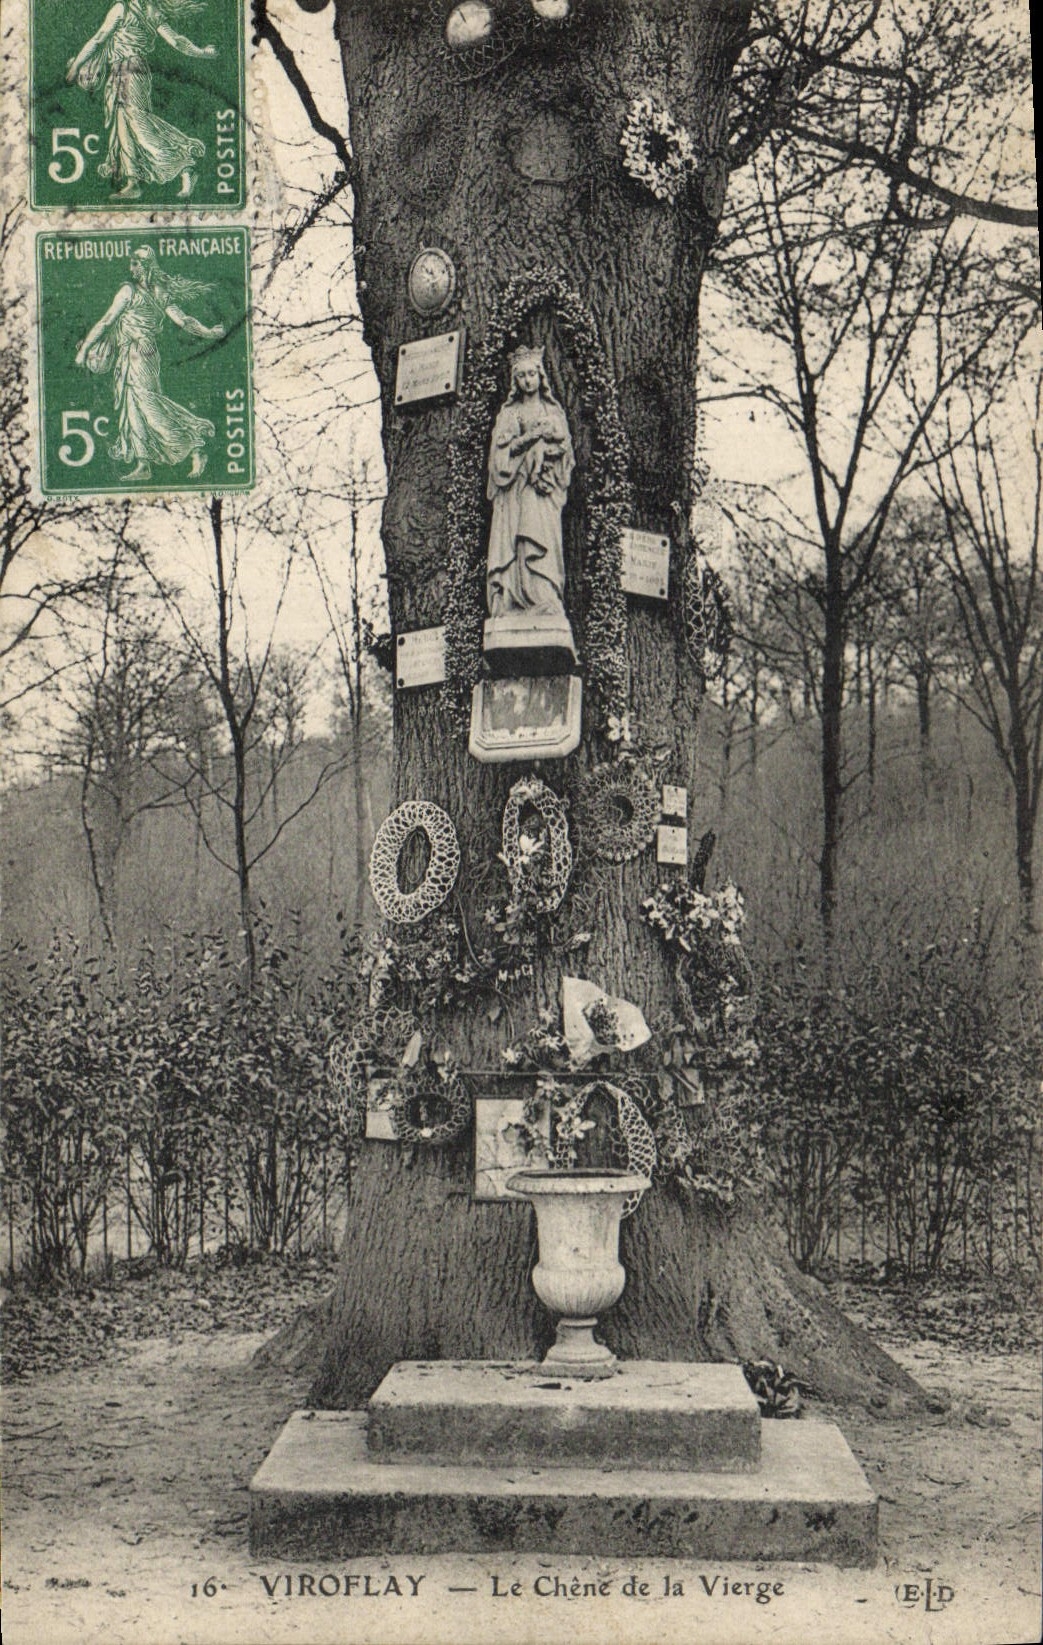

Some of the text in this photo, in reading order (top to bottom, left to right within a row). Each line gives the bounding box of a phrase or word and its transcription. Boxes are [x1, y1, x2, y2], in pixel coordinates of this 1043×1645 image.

[216, 108, 236, 194] POSTES
[159, 236, 241, 258] FRANÇAISE
[226, 388, 246, 474] POSTES
